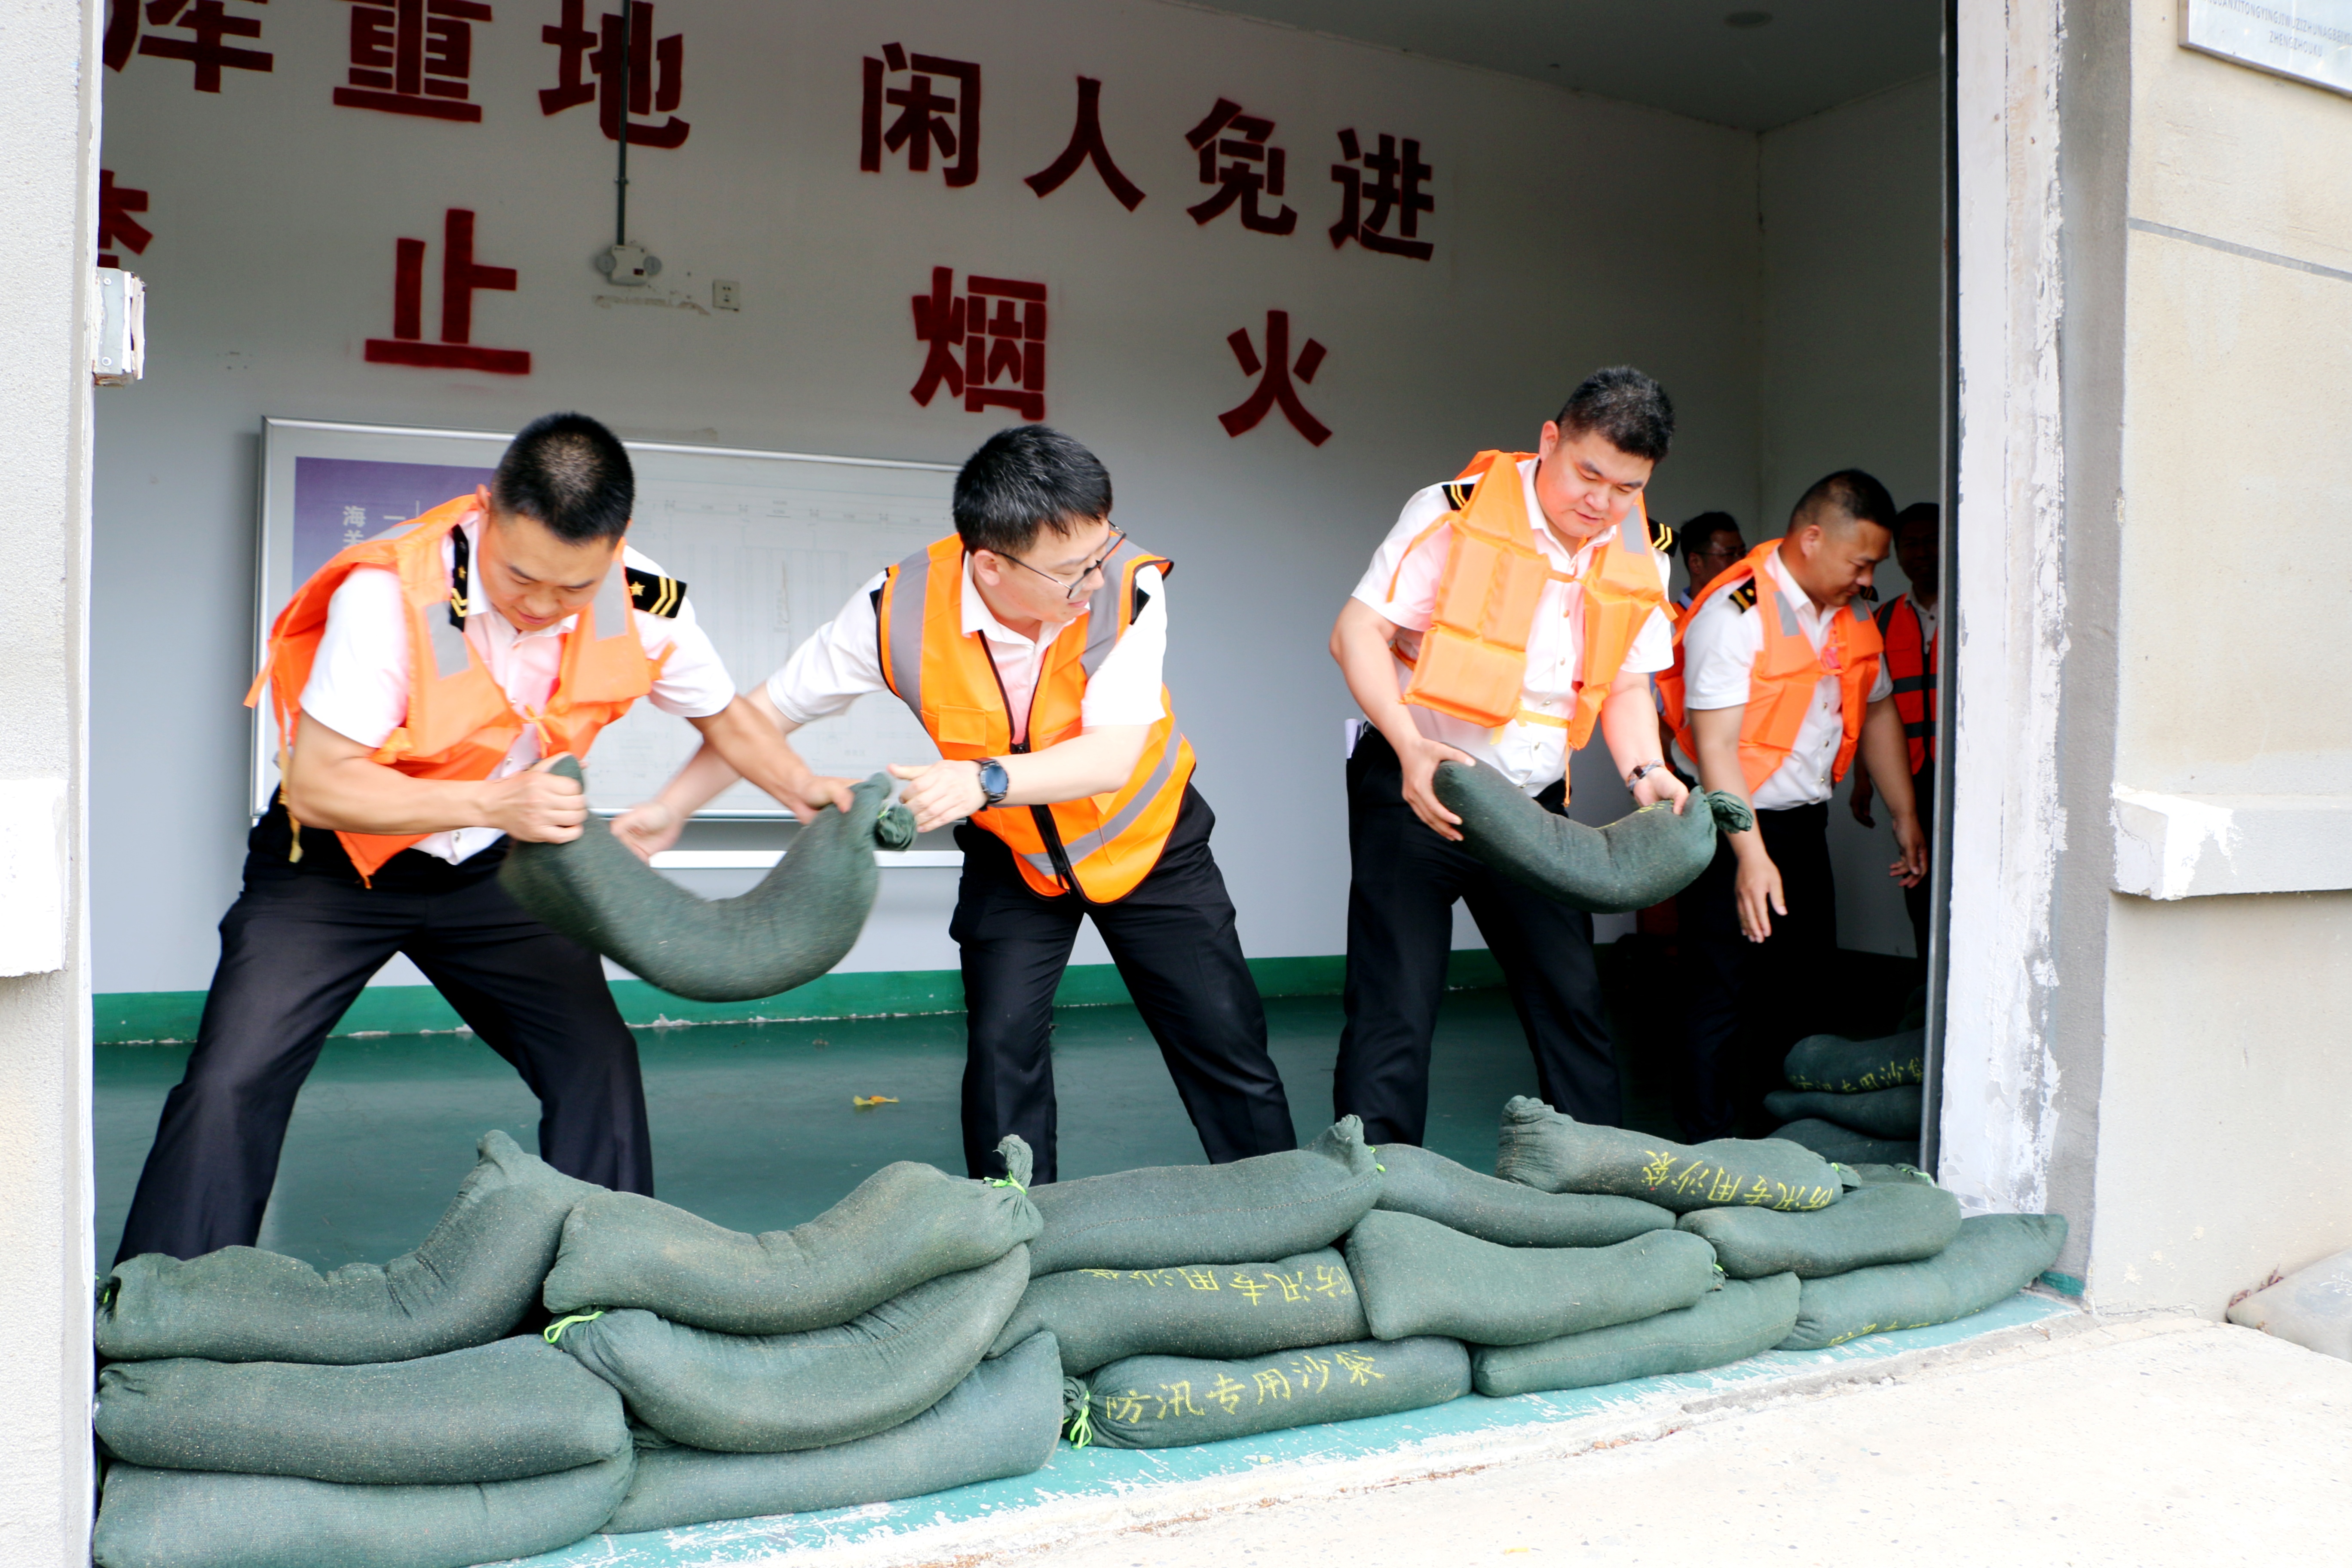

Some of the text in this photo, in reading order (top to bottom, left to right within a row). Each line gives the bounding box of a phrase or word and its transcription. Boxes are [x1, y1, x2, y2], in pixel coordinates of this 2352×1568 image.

[1641, 1150, 1833, 1211] 防汛专用沙袋
[1106, 1349, 1385, 1424] 防汛专用沙袋
